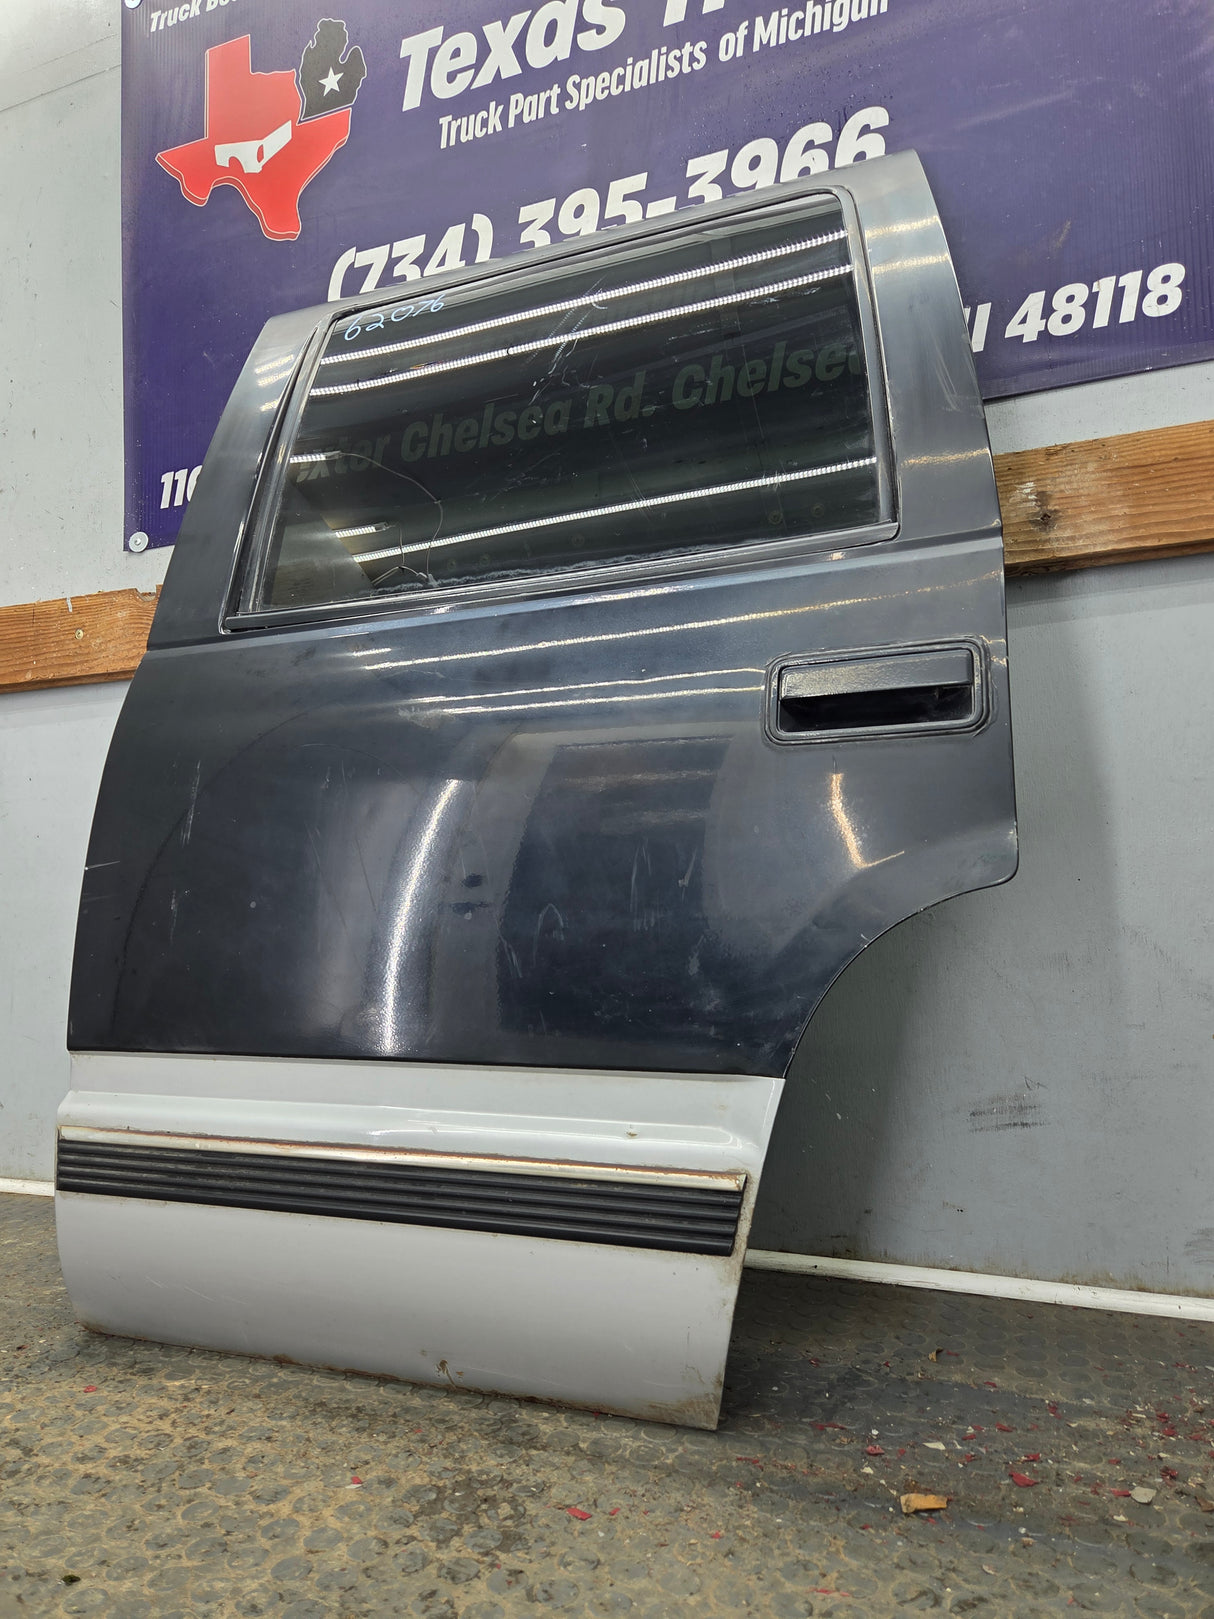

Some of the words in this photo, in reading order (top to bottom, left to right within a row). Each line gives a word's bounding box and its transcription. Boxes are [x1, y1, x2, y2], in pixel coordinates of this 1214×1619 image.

[150, 0, 201, 33] Truck
[400, 0, 627, 112] Texas
[439, 101, 504, 149] Truck
[508, 84, 562, 128] Part
[565, 41, 708, 111] Specialists
[718, 20, 749, 62] of
[752, 0, 889, 53] Michigan
[328, 213, 494, 302] (734)
[518, 106, 890, 249] 395-3966
[344, 293, 446, 341] 62076
[401, 398, 572, 464] Chelsea
[584, 371, 657, 429] Rd.
[1005, 262, 1186, 343] 48118
